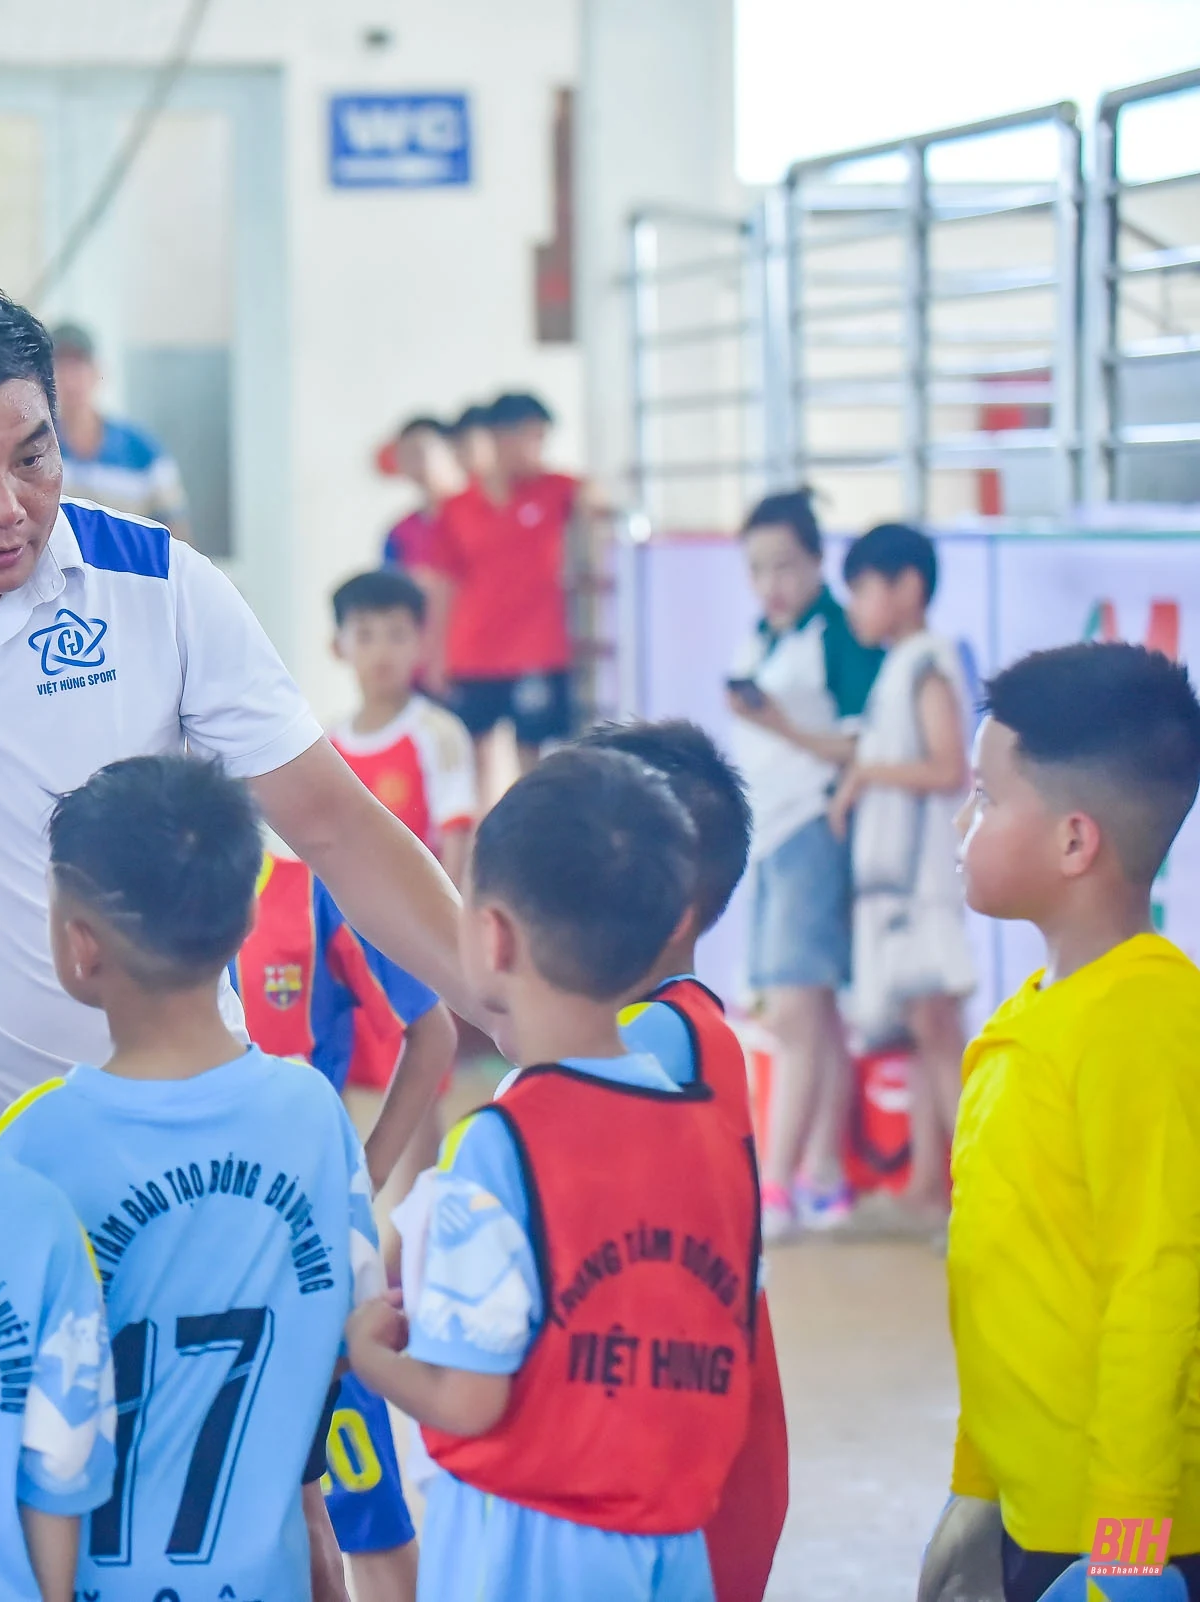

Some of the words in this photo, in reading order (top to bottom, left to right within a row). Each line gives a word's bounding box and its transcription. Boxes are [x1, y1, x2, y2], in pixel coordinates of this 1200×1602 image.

[37, 681, 58, 696] VIỆT
[60, 676, 86, 691] HÙNG
[87, 669, 117, 686] SPORT
[164, 1162, 205, 1209] TẠO
[208, 1151, 263, 1199] BÓNG
[89, 1304, 275, 1566] 17
[320, 1408, 382, 1496] 0
